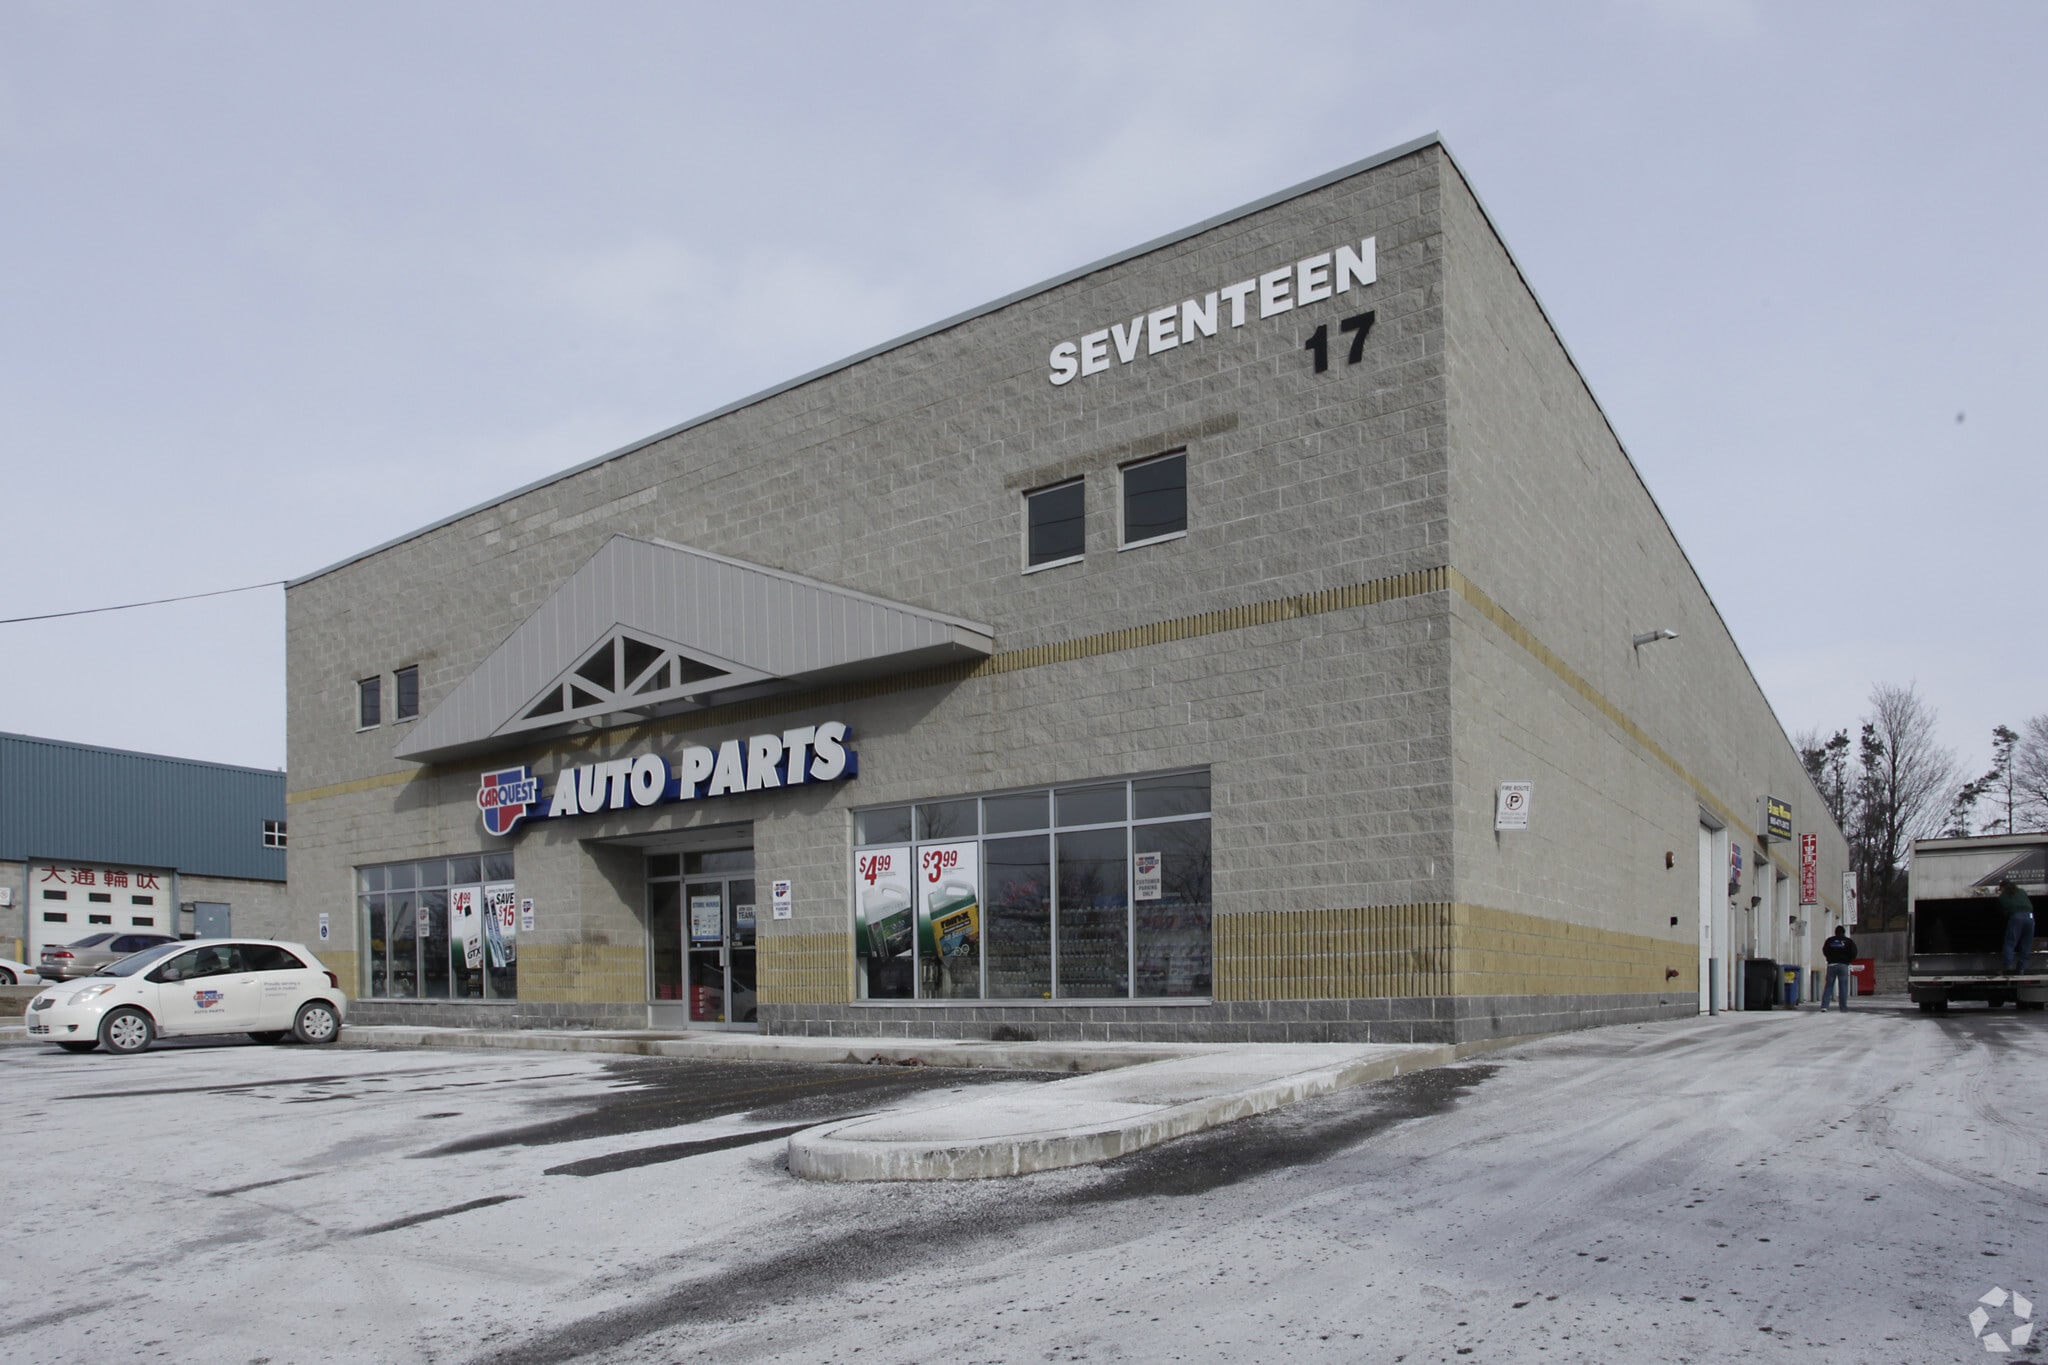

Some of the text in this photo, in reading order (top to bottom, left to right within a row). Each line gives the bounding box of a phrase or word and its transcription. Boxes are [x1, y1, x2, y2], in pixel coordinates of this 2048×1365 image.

[1049, 236, 1377, 385] SEVENTEEN
[1305, 310, 1375, 374] 17
[549, 721, 847, 817] AUTO PARTS
[479, 780, 535, 808] CARQUEST
[496, 893, 515, 905] SAVE
[498, 905, 515, 926] $15
[467, 946, 482, 959] GTX
